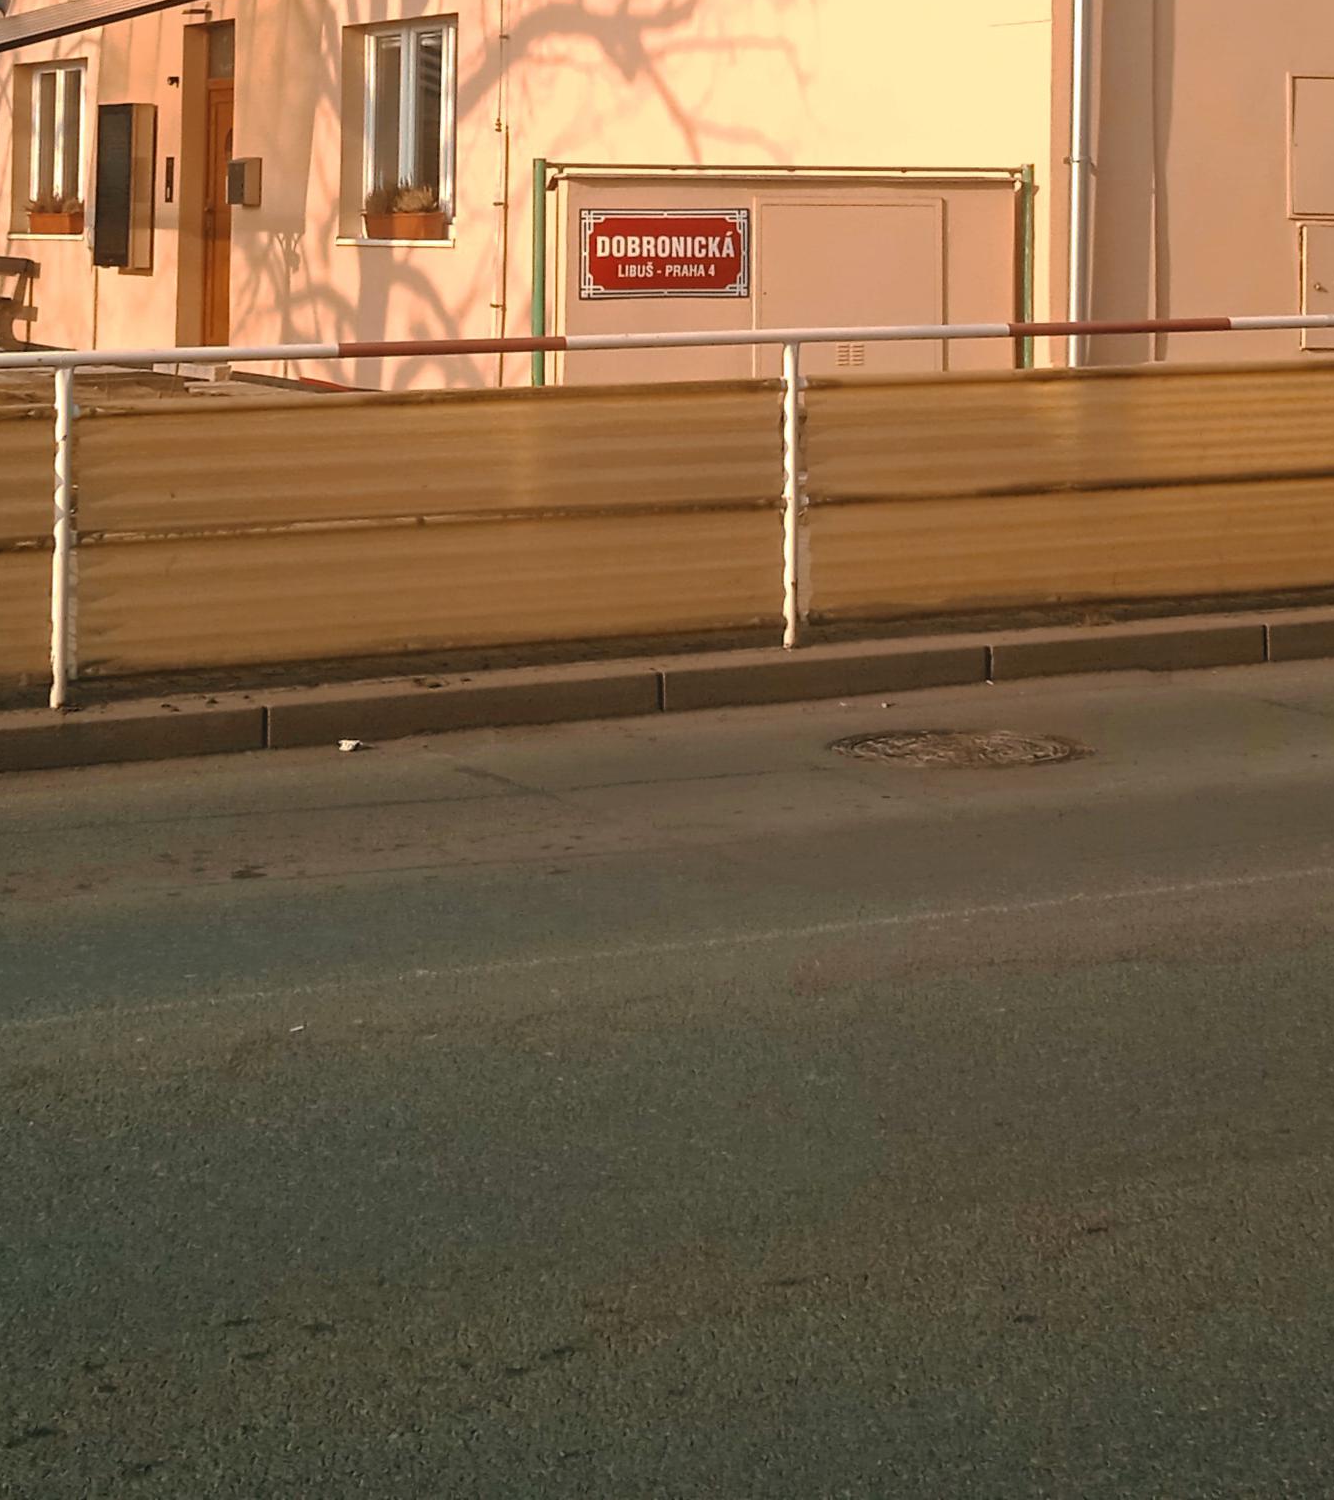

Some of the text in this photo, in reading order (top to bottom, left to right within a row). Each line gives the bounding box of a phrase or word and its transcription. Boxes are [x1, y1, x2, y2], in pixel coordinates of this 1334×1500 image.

[596, 231, 735, 258] DOBRONICKÁ
[618, 262, 654, 278] LIBUŠ
[665, 264, 705, 277] PRAHA
[708, 264, 716, 277] 4
